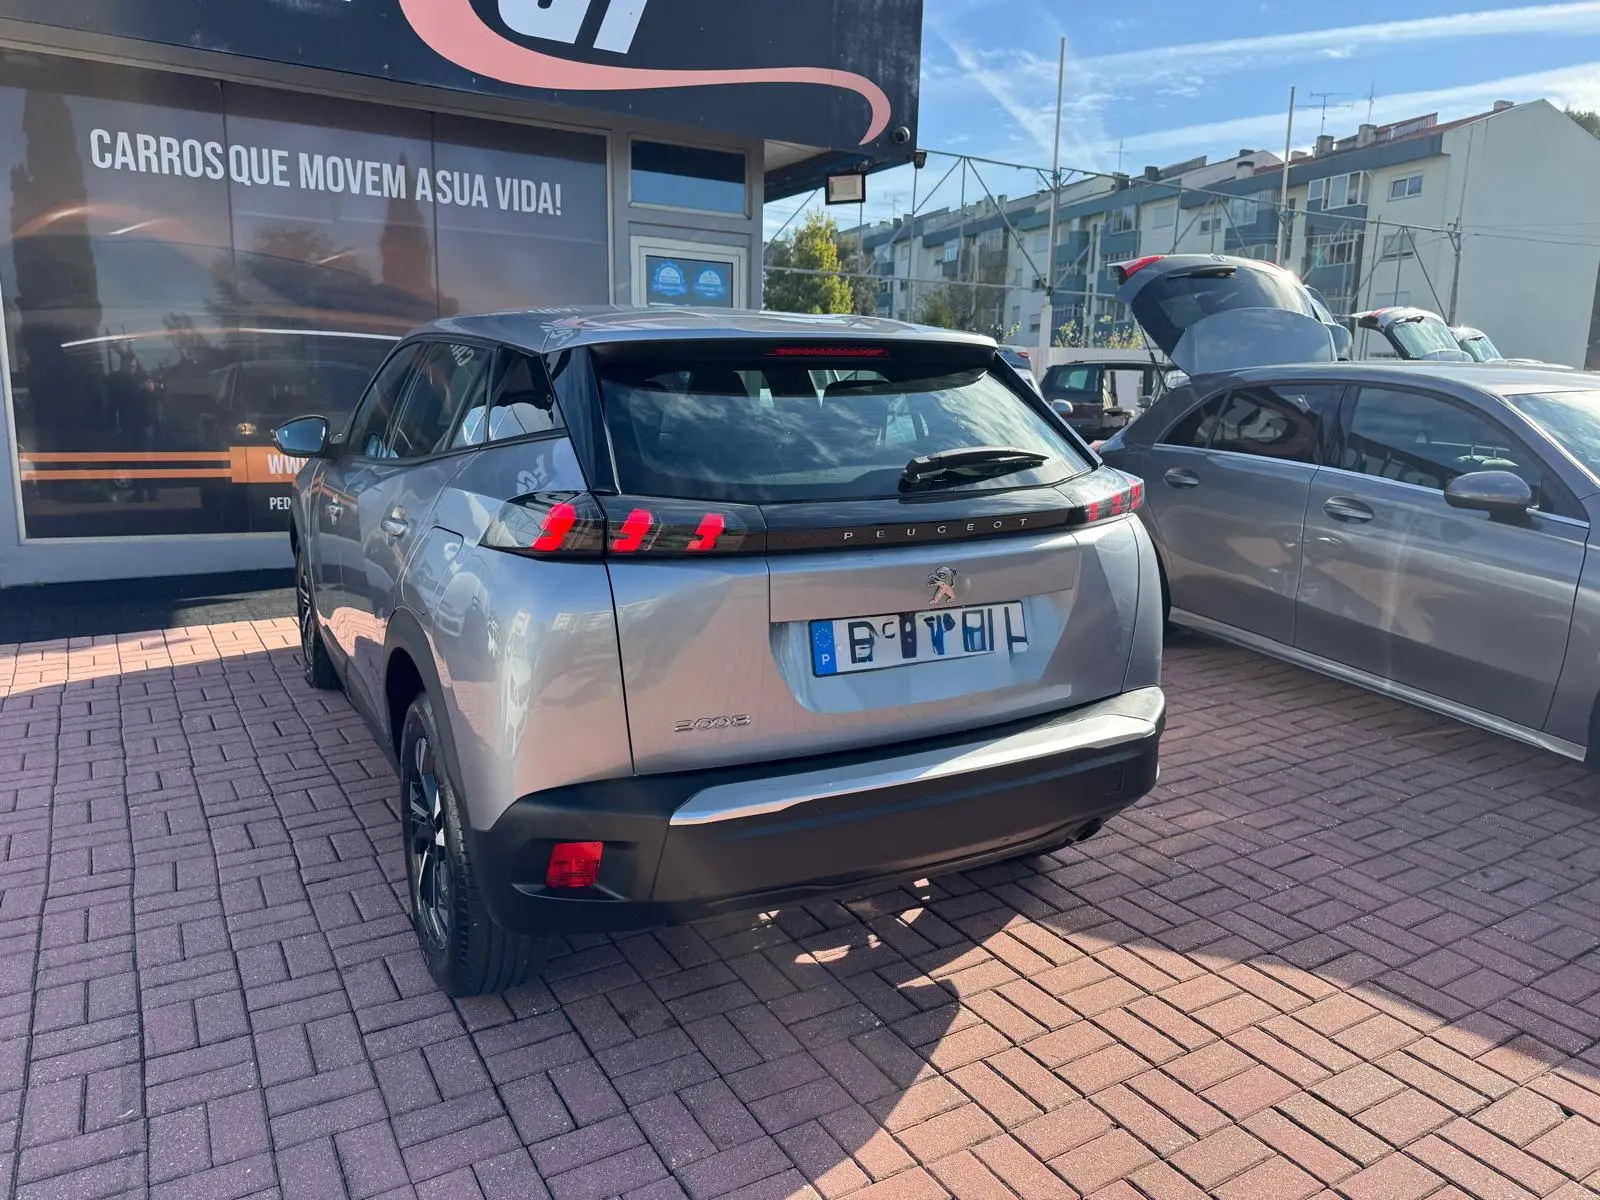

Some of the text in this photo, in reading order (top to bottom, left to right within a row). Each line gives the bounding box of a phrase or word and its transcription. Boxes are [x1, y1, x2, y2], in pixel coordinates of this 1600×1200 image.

[90, 128, 562, 216] CARROS QUE MOVEM A SUA VIDA!
[267, 453, 309, 475] WW
[843, 518, 1028, 540] PEUGEOT
[821, 654, 831, 665] P
[674, 714, 751, 732] 2008
